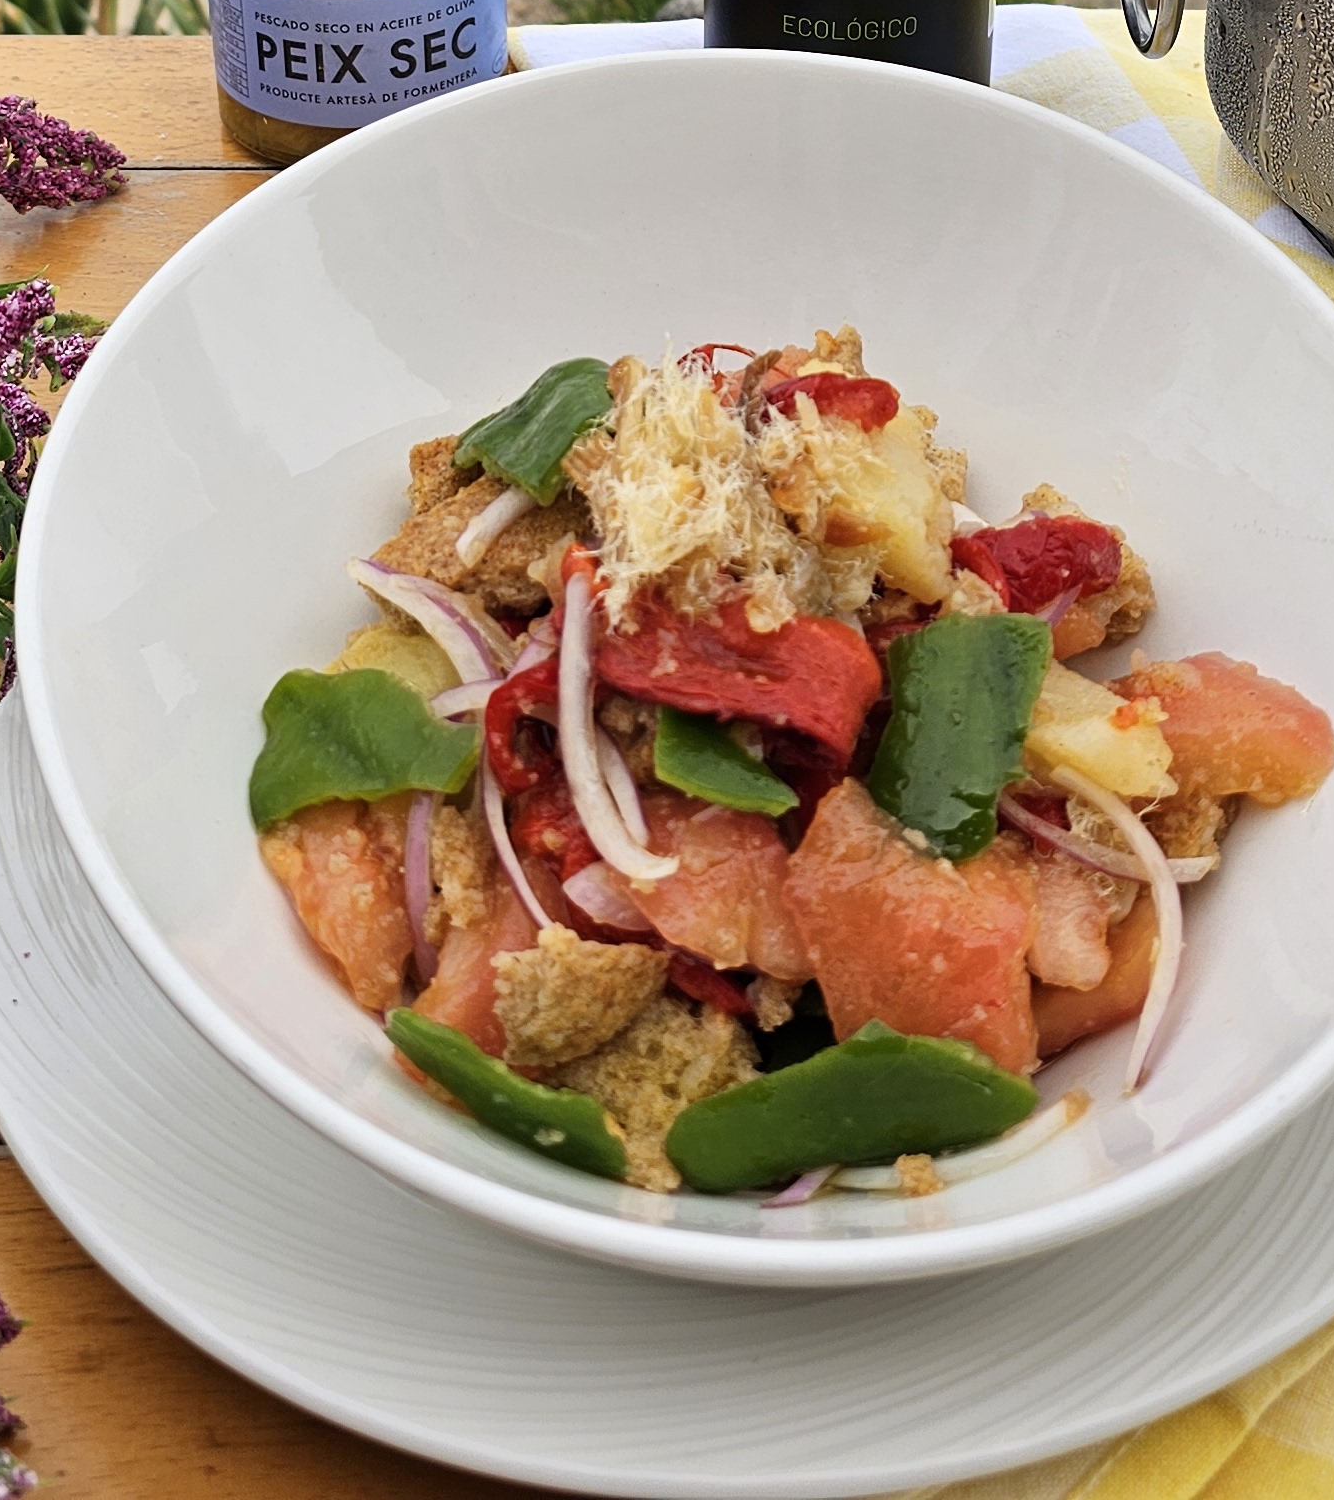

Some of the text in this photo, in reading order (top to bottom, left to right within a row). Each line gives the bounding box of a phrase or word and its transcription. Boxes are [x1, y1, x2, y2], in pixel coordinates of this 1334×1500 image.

[254, 11, 310, 32] PESCADO
[315, 23, 350, 34] SECO
[356, 23, 374, 33] EN
[379, 14, 423, 32] ACEITE
[427, 9, 442, 22] DE
[782, 13, 917, 42] ECOLÓGICO
[255, 31, 367, 84] PEIX
[389, 16, 477, 79] SEC
[260, 67, 478, 105] PRODUCTE ARTESÀ DE FORMENTERA
